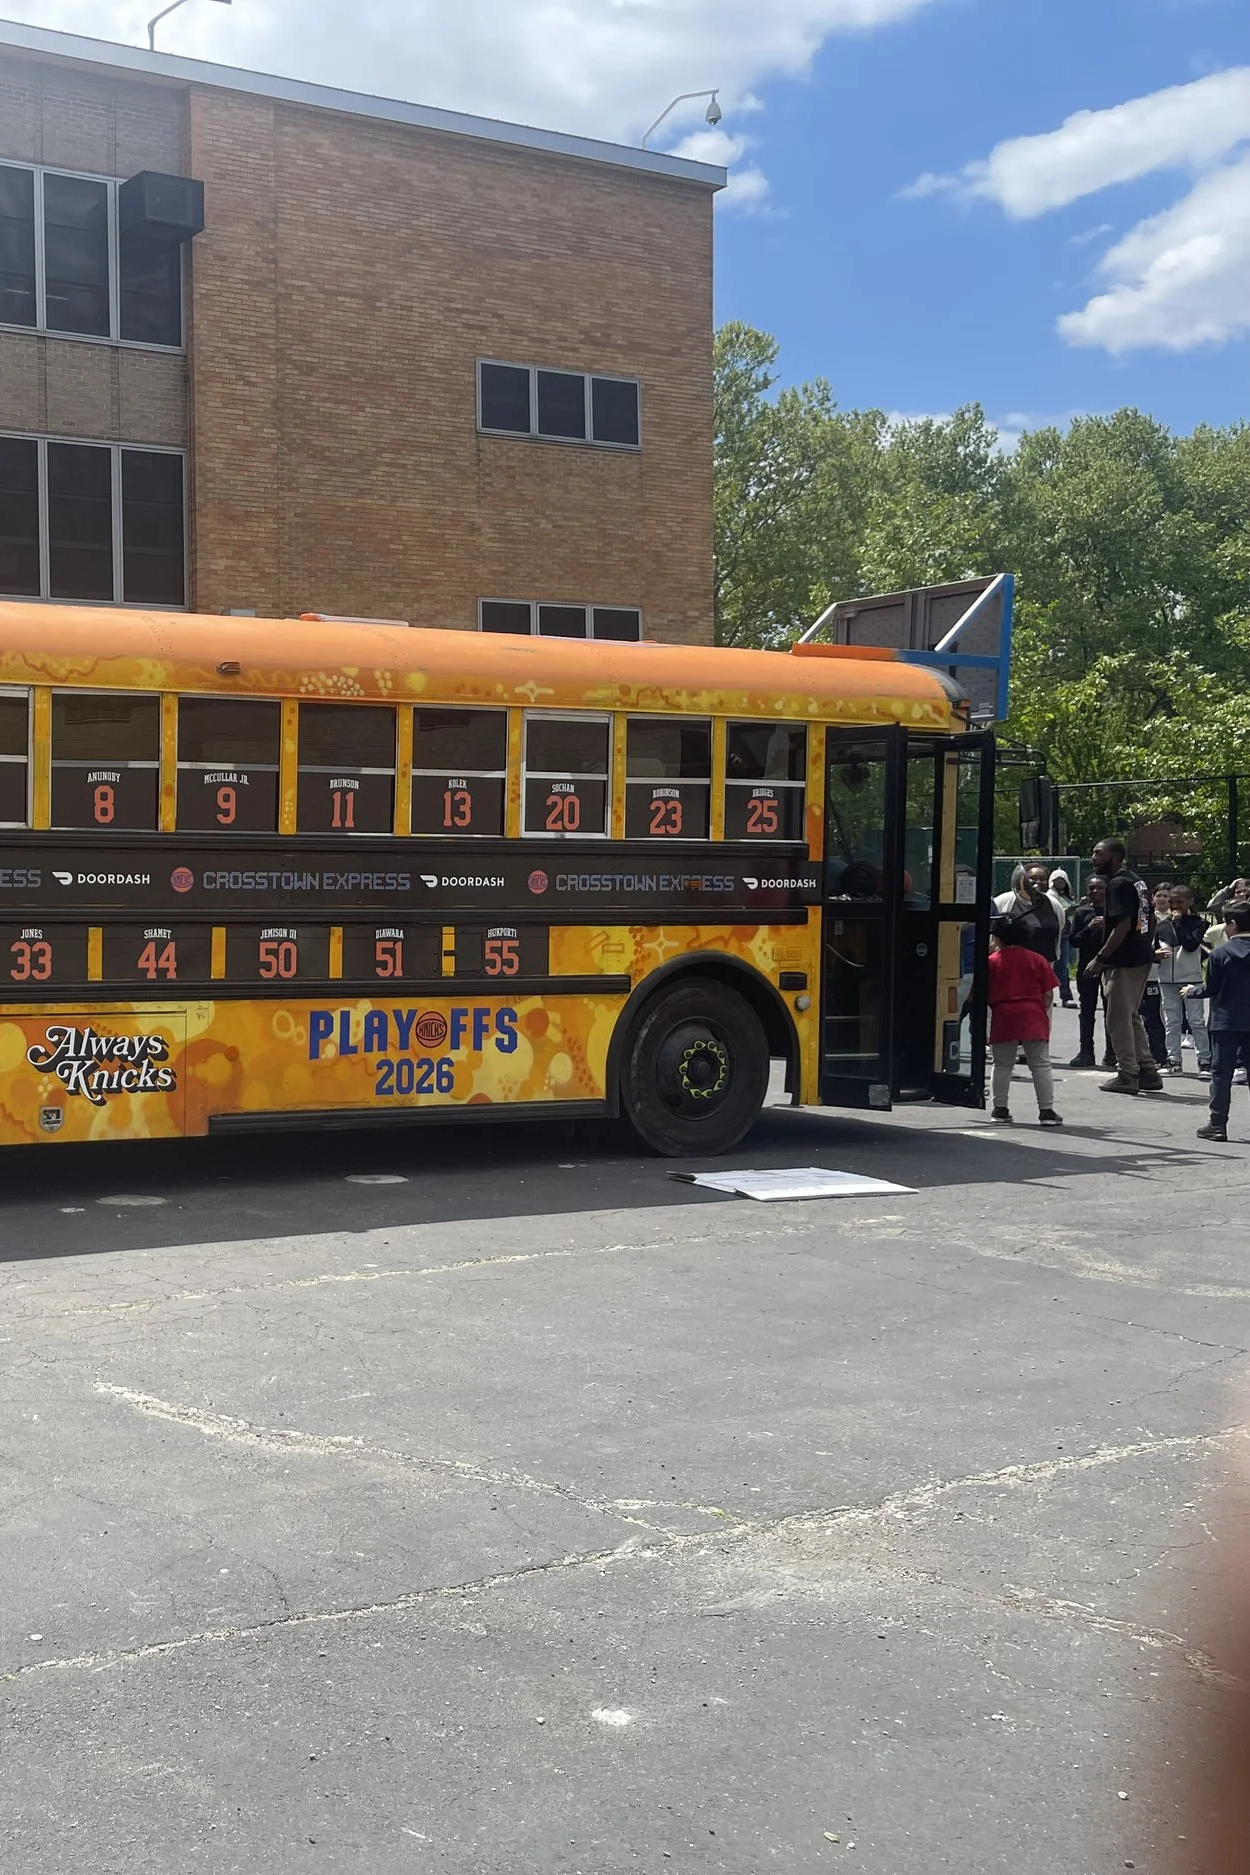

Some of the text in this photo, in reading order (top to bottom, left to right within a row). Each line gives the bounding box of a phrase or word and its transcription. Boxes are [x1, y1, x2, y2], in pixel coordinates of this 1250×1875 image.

[86, 771, 122, 783] ANUNOBY
[203, 772, 238, 785] MCCULLAR
[329, 778, 360, 790] BRUNSON
[448, 778, 468, 790] KOLEK
[551, 782, 575, 794] SOCHAN
[93, 784, 115, 824] 8
[216, 786, 237, 825] 9
[652, 788, 680, 799] ROBINSON
[331, 791, 355, 828] 11
[442, 790, 472, 827] 13
[545, 794, 581, 831] 20
[649, 800, 683, 835] 23
[746, 799, 779, 833] 25
[77, 873, 151, 885] DOORDASH
[202, 872, 319, 890] CROSSTOWN
[323, 873, 411, 891] EXPRESS
[442, 876, 505, 887] DOORDASH
[555, 874, 657, 892] CROSSTOWN
[761, 878, 817, 888] DOORDASH
[20, 928, 44, 940] JONES
[143, 928, 173, 940] SHAMET
[260, 928, 287, 940] JEMISON
[375, 928, 405, 940] DIAWARA
[10, 941, 53, 981] 33
[137, 941, 178, 980] 44
[258, 941, 298, 979] 50
[375, 941, 404, 977] 51
[485, 940, 520, 976] 55
[27, 1025, 165, 1067] Always
[55, 1059, 174, 1104] Knicks
[374, 1056, 455, 1096] 2026
